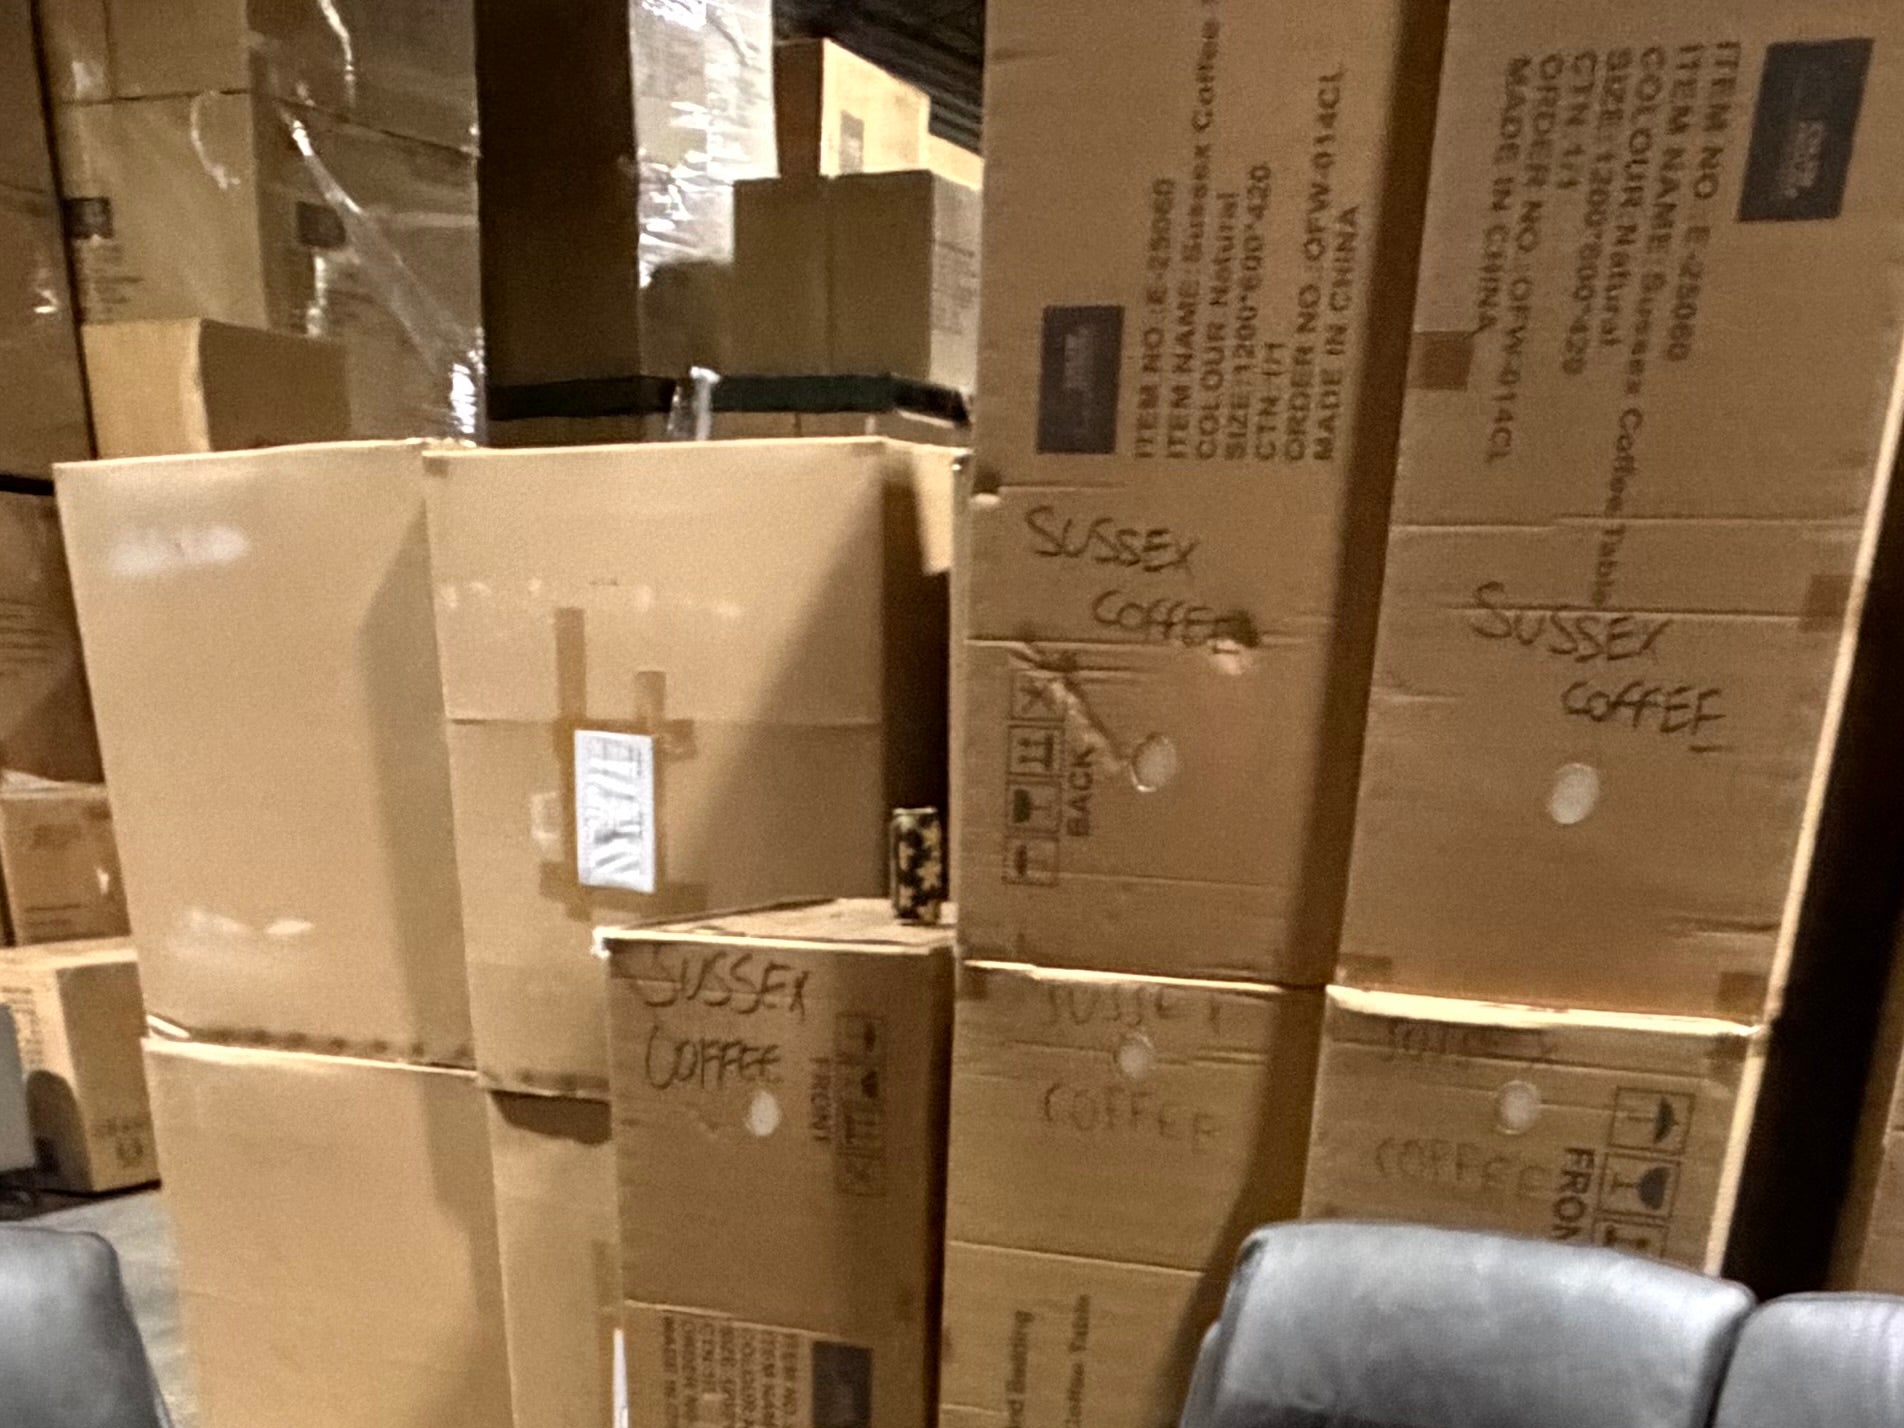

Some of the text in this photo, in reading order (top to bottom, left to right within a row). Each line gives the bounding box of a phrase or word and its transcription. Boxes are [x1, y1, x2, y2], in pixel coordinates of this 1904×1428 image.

[1522, 53, 1565, 187] ORDER
[1564, 51, 1598, 127] CTN
[1620, 46, 1667, 208] COLOUR
[1663, 43, 1707, 136] ITEM
[1702, 41, 1742, 132] ITEM
[1476, 56, 1533, 332] MADE IN CHINA
[1312, 204, 1359, 461] MADE IN CHINA
[1134, 385, 1159, 459] ITEM
[1166, 385, 1190, 459] ITEM
[1196, 322, 1227, 461] COLOUR
[1253, 395, 1279, 461] CTN
[1284, 345, 1314, 462] ORDER
[1024, 504, 1200, 577] SUSSEX
[1471, 581, 1674, 664] SUSSEX
[1066, 745, 1094, 837] BACK
[631, 949, 810, 1023] SUSSEX
[645, 1023, 784, 1090] COFFEE
[1552, 1147, 1597, 1241] FRON
